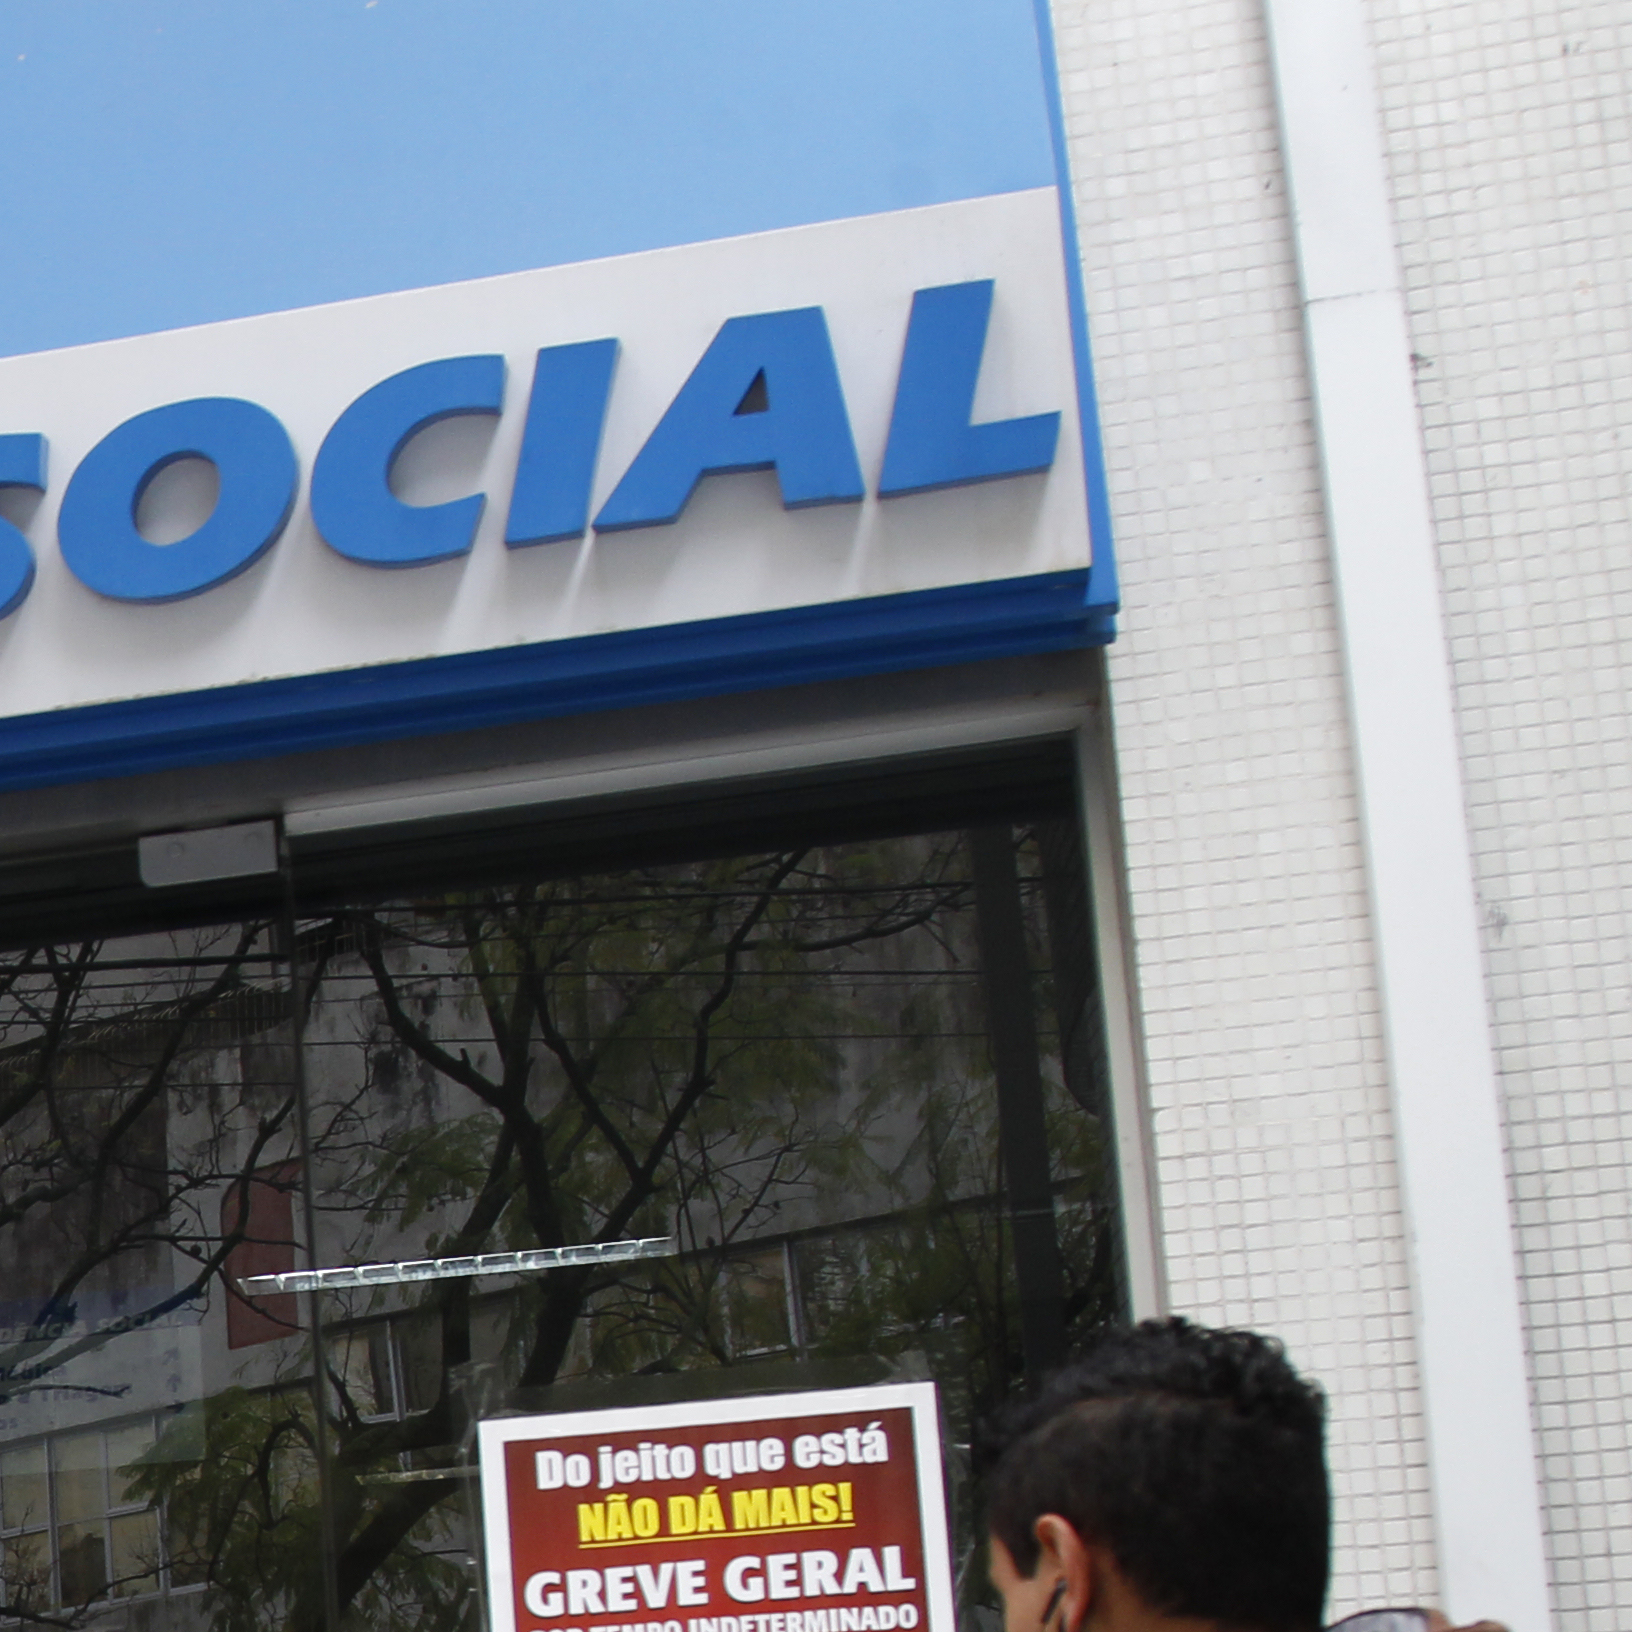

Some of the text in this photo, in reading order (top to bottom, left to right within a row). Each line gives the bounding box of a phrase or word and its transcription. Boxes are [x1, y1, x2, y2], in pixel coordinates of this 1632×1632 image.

[536, 1422, 889, 1489] Do jeito que está
[576, 1482, 853, 1541] NÃO DÁ MAIS!
[523, 1543, 916, 1617] GREVE GERAL
